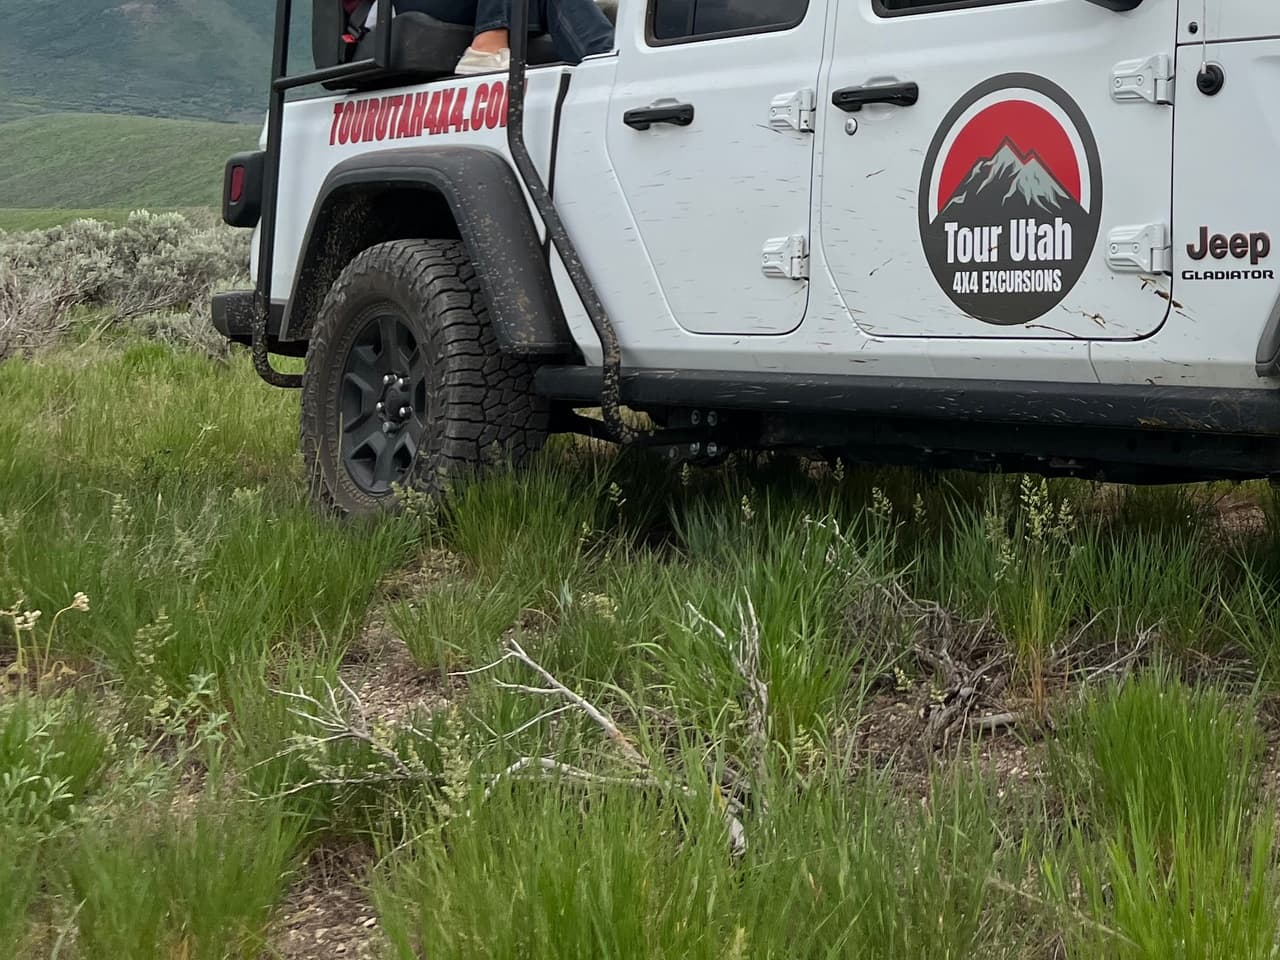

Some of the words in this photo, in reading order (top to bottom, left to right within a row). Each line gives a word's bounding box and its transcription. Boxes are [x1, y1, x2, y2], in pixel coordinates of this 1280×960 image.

[944, 222, 1003, 263] Tour
[1009, 217, 1072, 261] Utah
[1186, 226, 1270, 265] Jeep
[952, 271, 979, 293] 4X4
[982, 269, 1062, 293] EXCURSIONS
[1181, 269, 1274, 280] GLADIATOR
